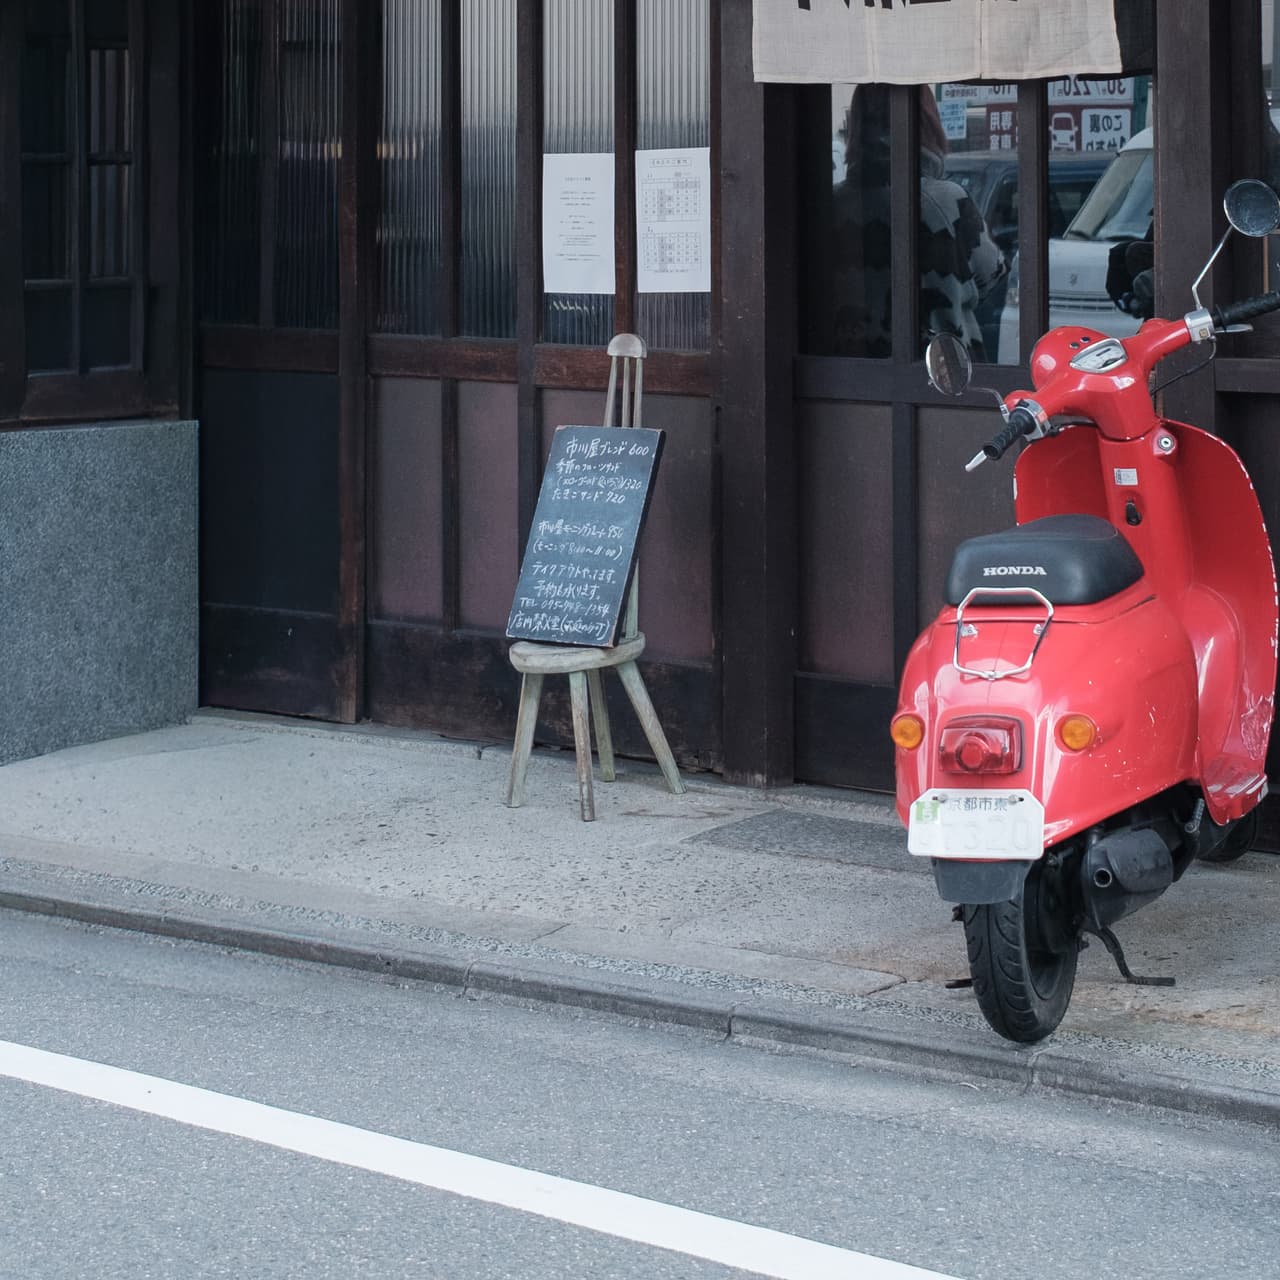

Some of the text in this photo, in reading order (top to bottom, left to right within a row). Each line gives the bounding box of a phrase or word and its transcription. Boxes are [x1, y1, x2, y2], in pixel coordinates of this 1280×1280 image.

[566, 435, 650, 460] 市川屋ブレンド 600
[983, 566, 1047, 576] HONDA
